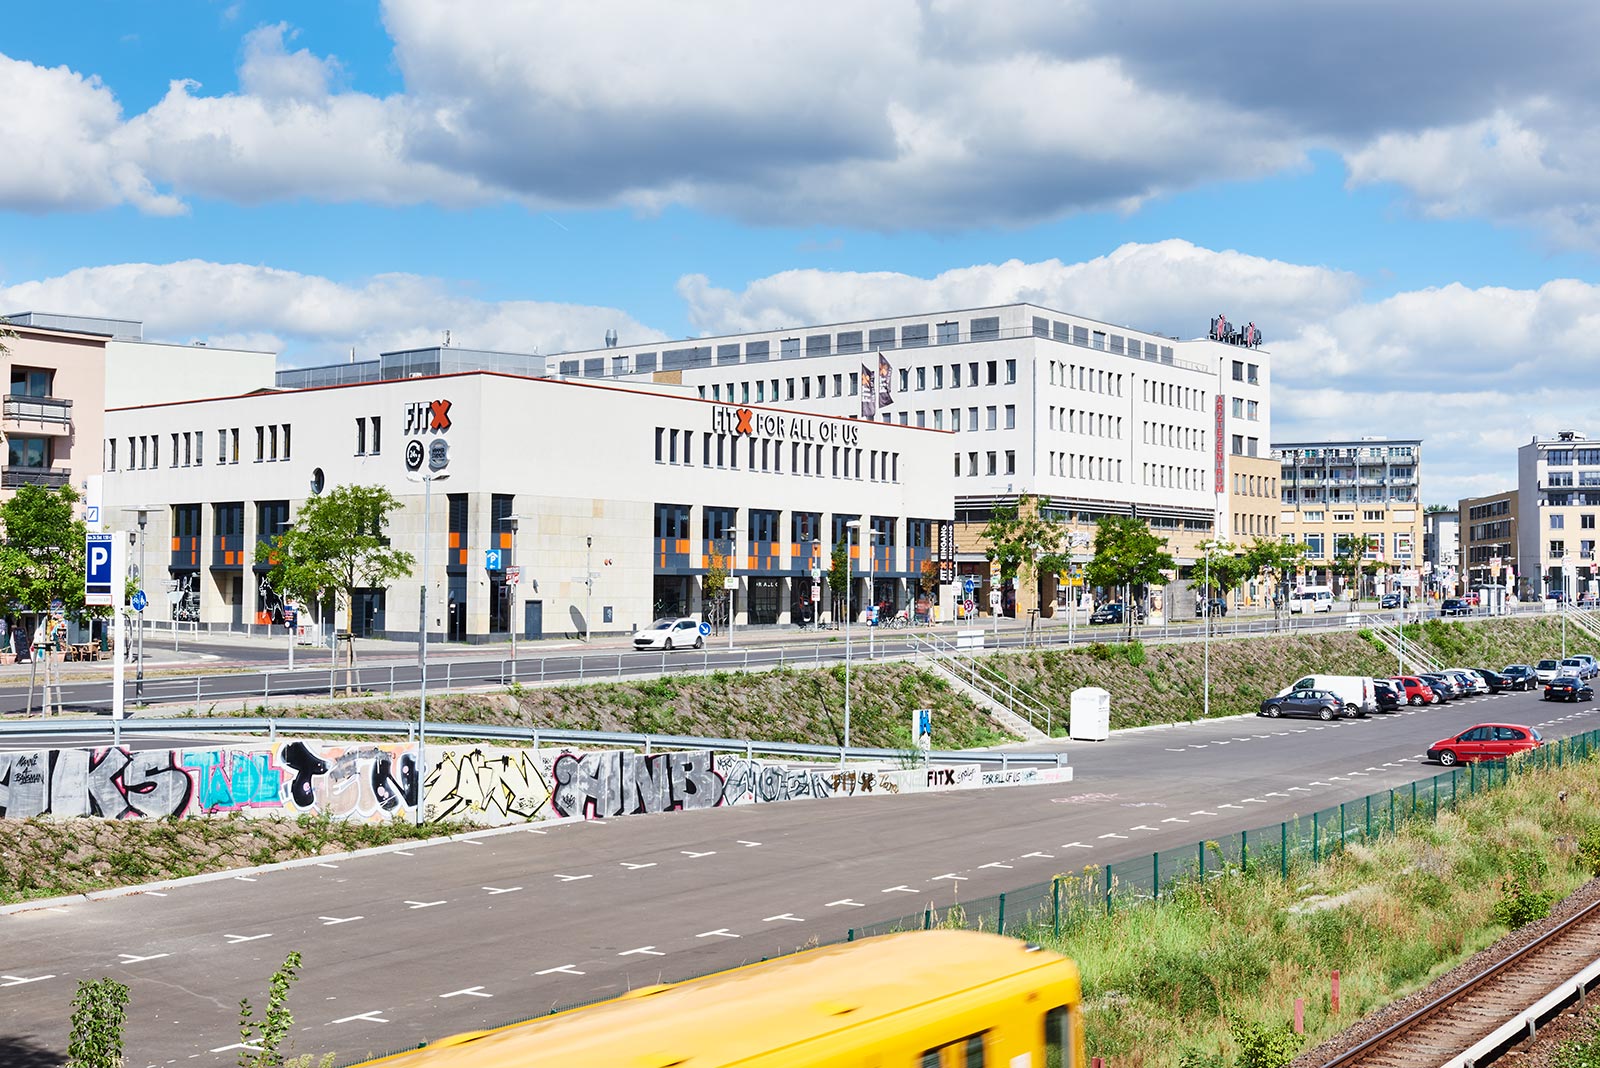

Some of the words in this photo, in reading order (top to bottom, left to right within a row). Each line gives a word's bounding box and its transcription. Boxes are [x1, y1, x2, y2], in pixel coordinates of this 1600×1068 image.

[403, 399, 453, 432] FITX
[712, 405, 753, 435] FITX
[757, 413, 785, 436] FOR
[790, 417, 814, 440] ALL
[819, 421, 838, 443] OF
[842, 424, 859, 445] US
[91, 547, 108, 575] P
[927, 769, 955, 788] FITX
